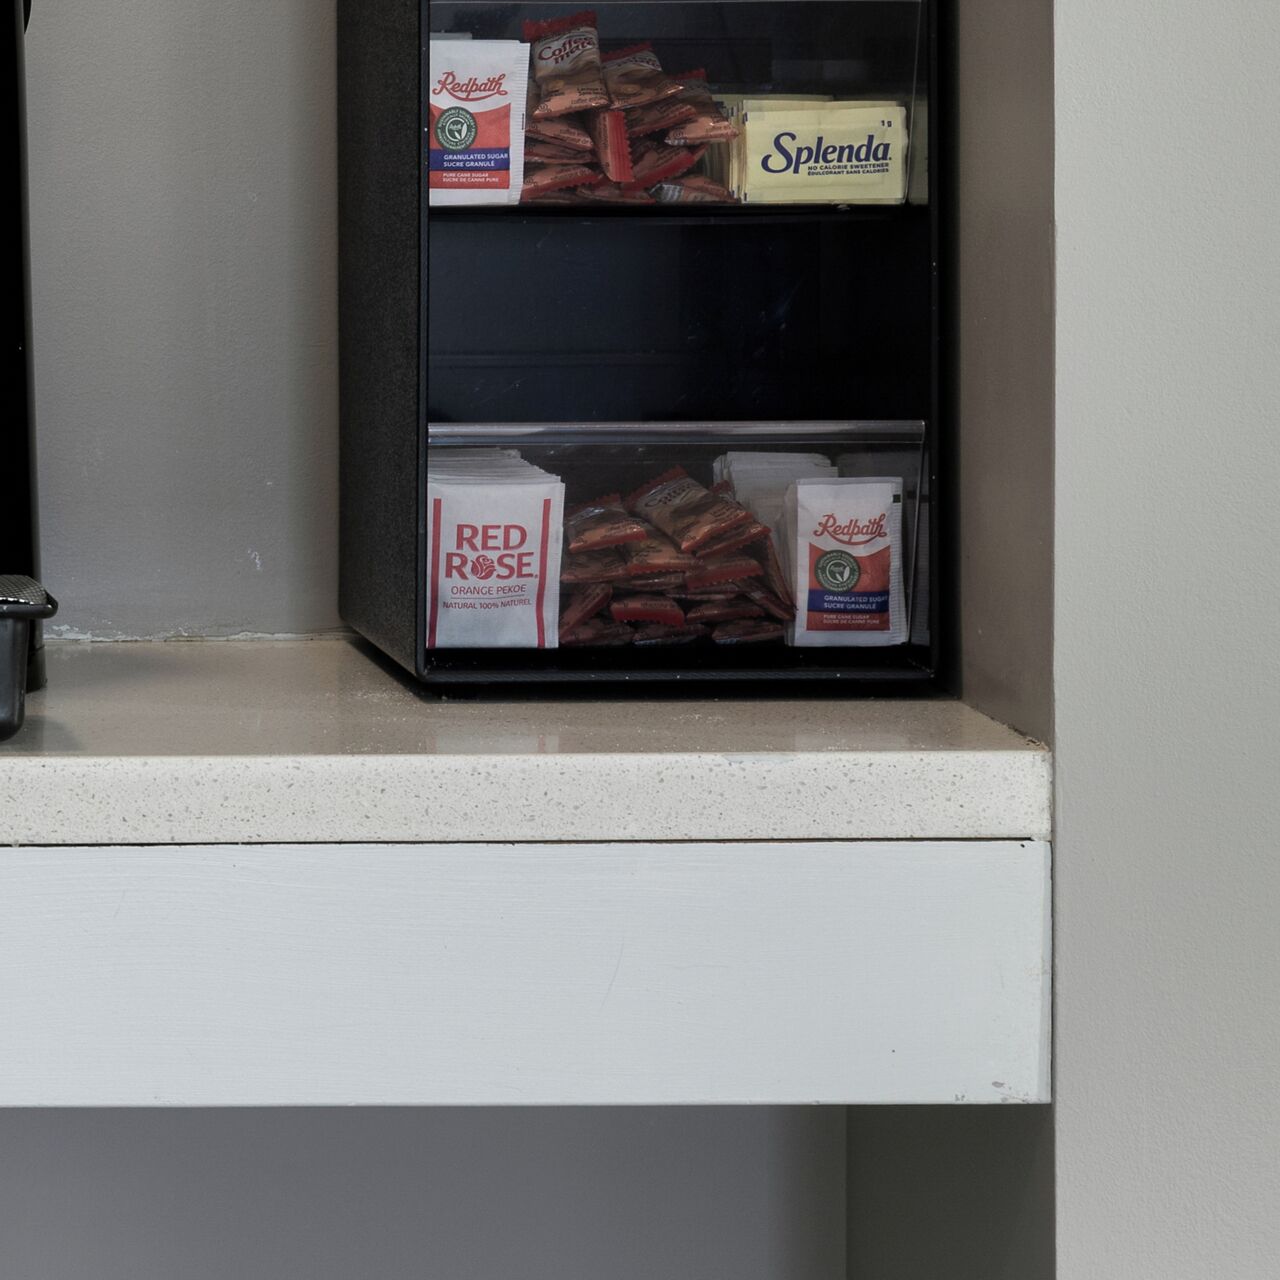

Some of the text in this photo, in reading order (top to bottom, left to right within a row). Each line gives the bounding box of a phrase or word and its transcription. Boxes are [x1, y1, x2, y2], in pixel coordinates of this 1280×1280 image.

[432, 70, 508, 102] Redpath
[761, 132, 890, 175] Splenda
[456, 524, 527, 551] RED
[813, 513, 888, 545] Redpath
[451, 584, 527, 595] ORANGE PEKOE
[443, 599, 531, 610] NATURAL 100% NATUREL
